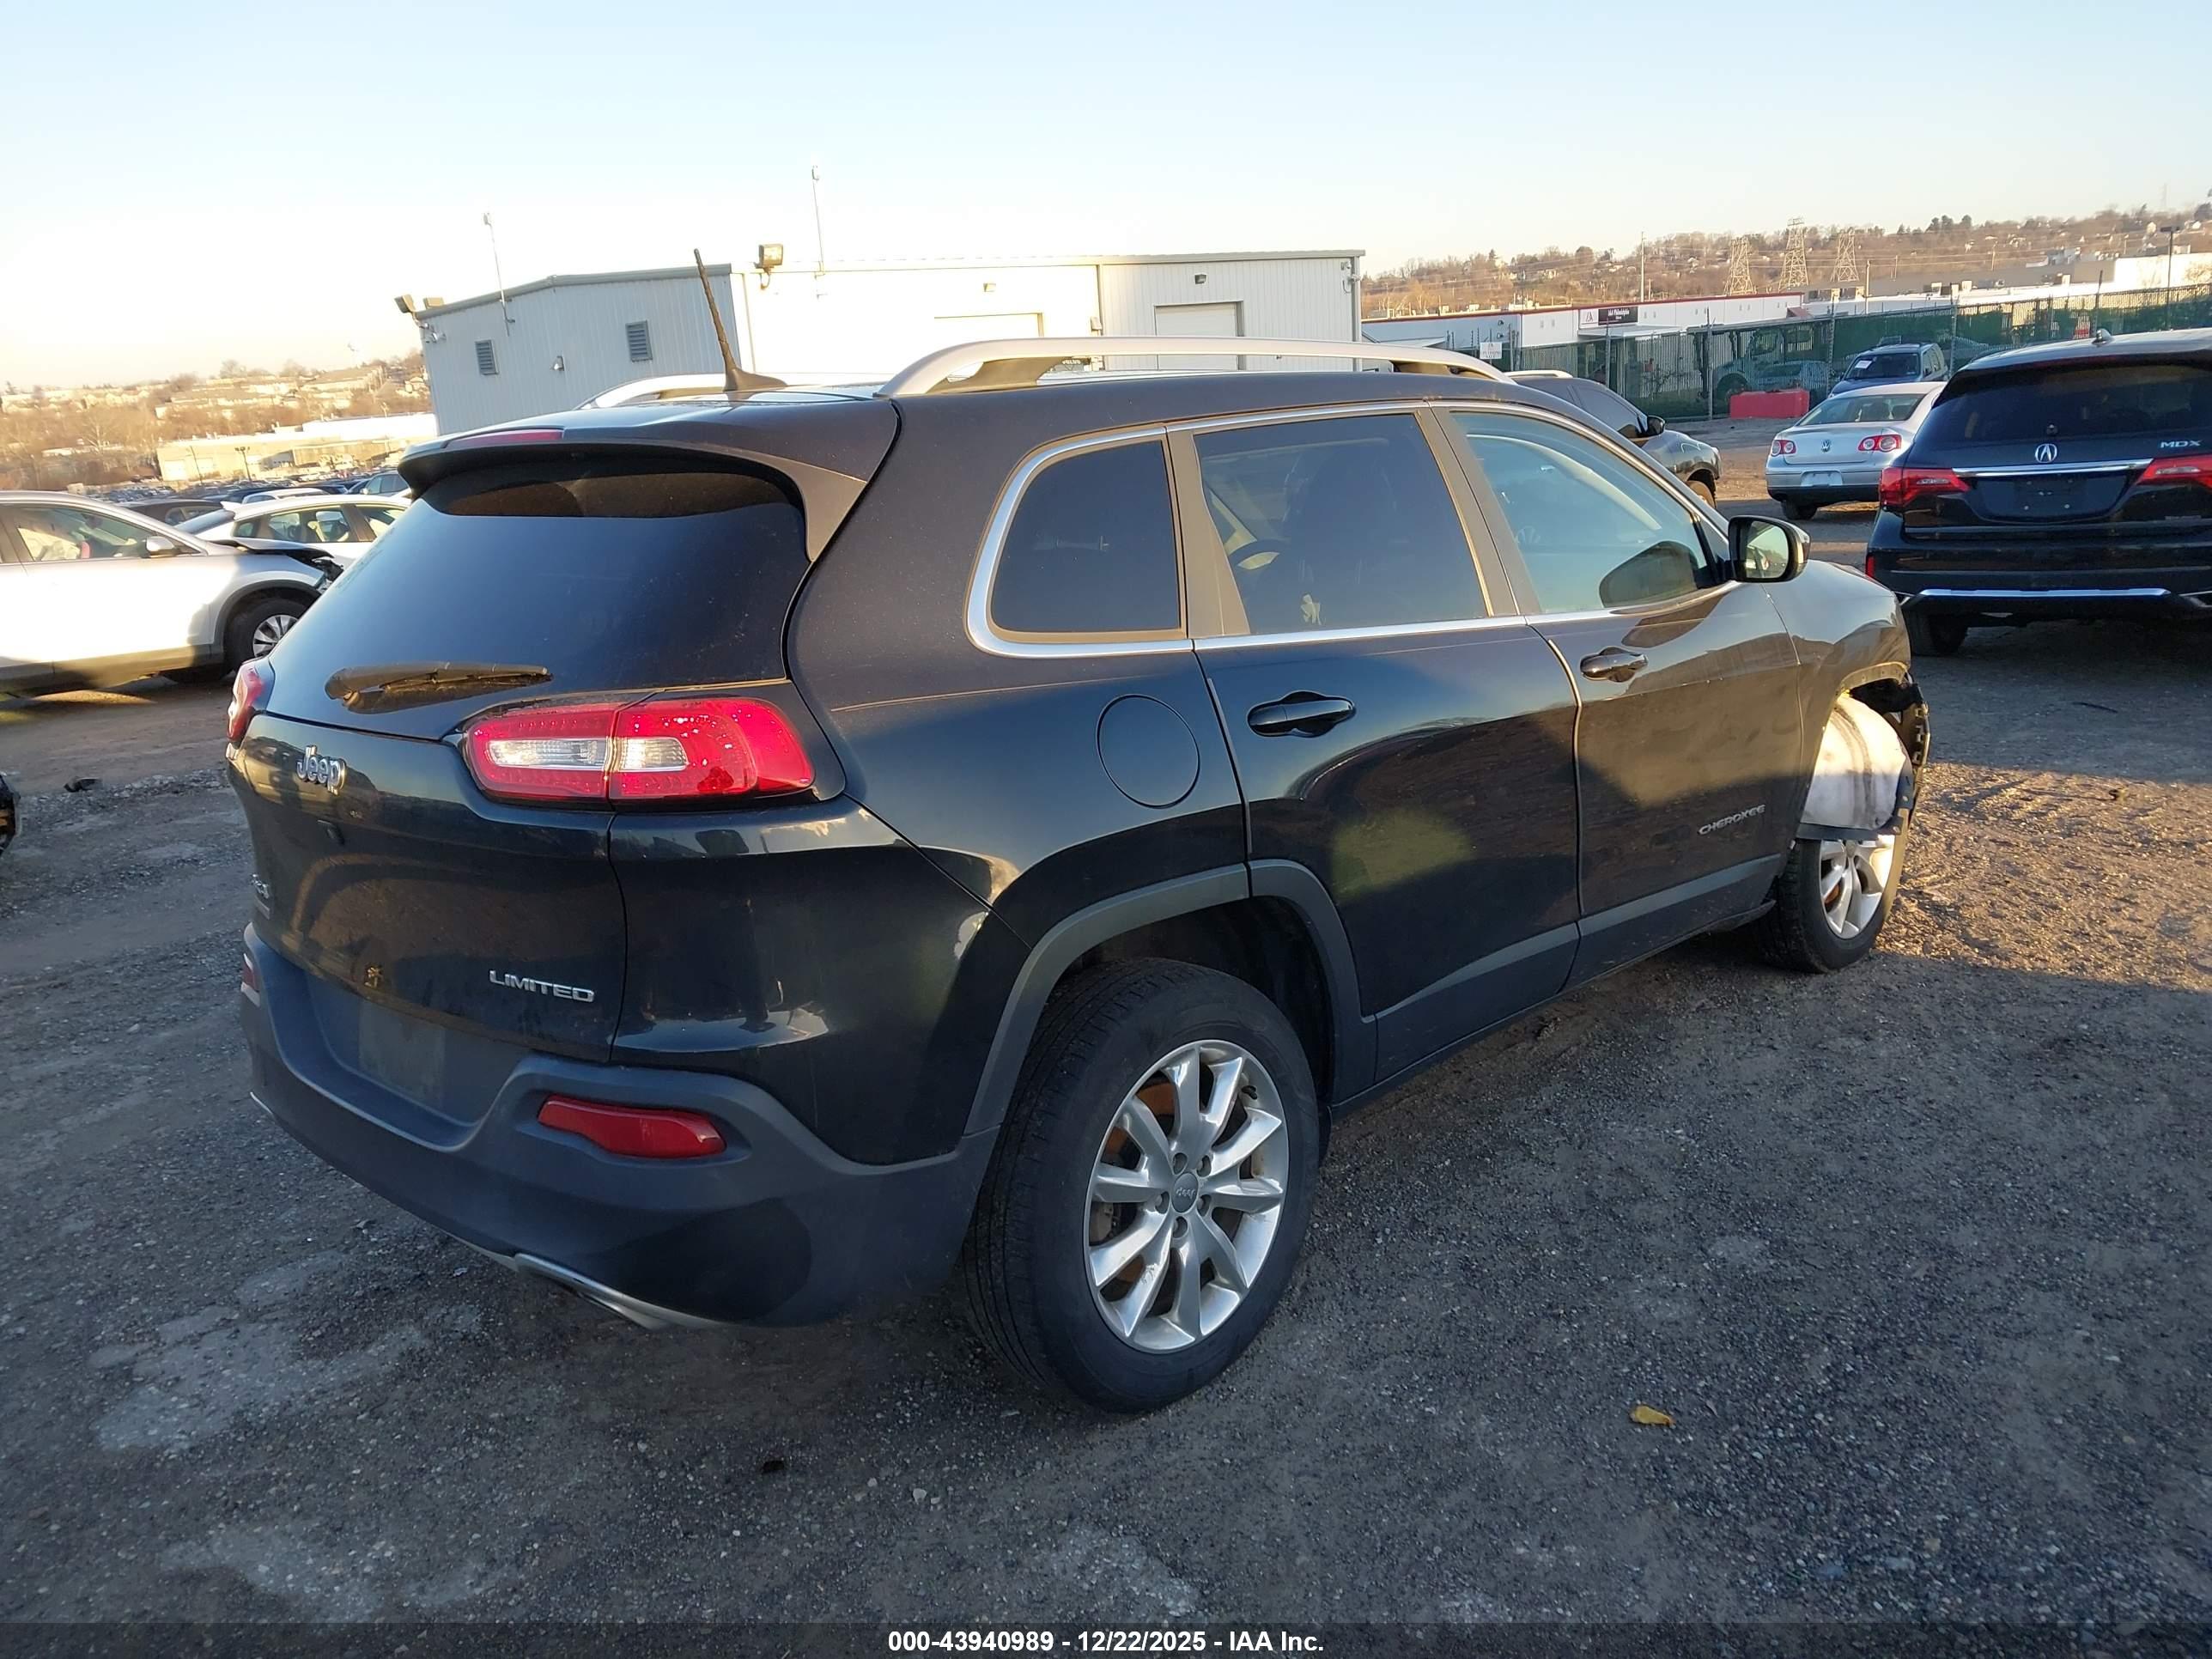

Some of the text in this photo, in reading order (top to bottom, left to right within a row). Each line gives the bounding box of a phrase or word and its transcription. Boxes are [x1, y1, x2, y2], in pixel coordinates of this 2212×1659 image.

[2160, 440, 2203, 448] MDX
[296, 746, 345, 795] Jeep
[1698, 804, 1766, 835] CHEROKEE
[489, 969, 595, 1003] LIMITED
